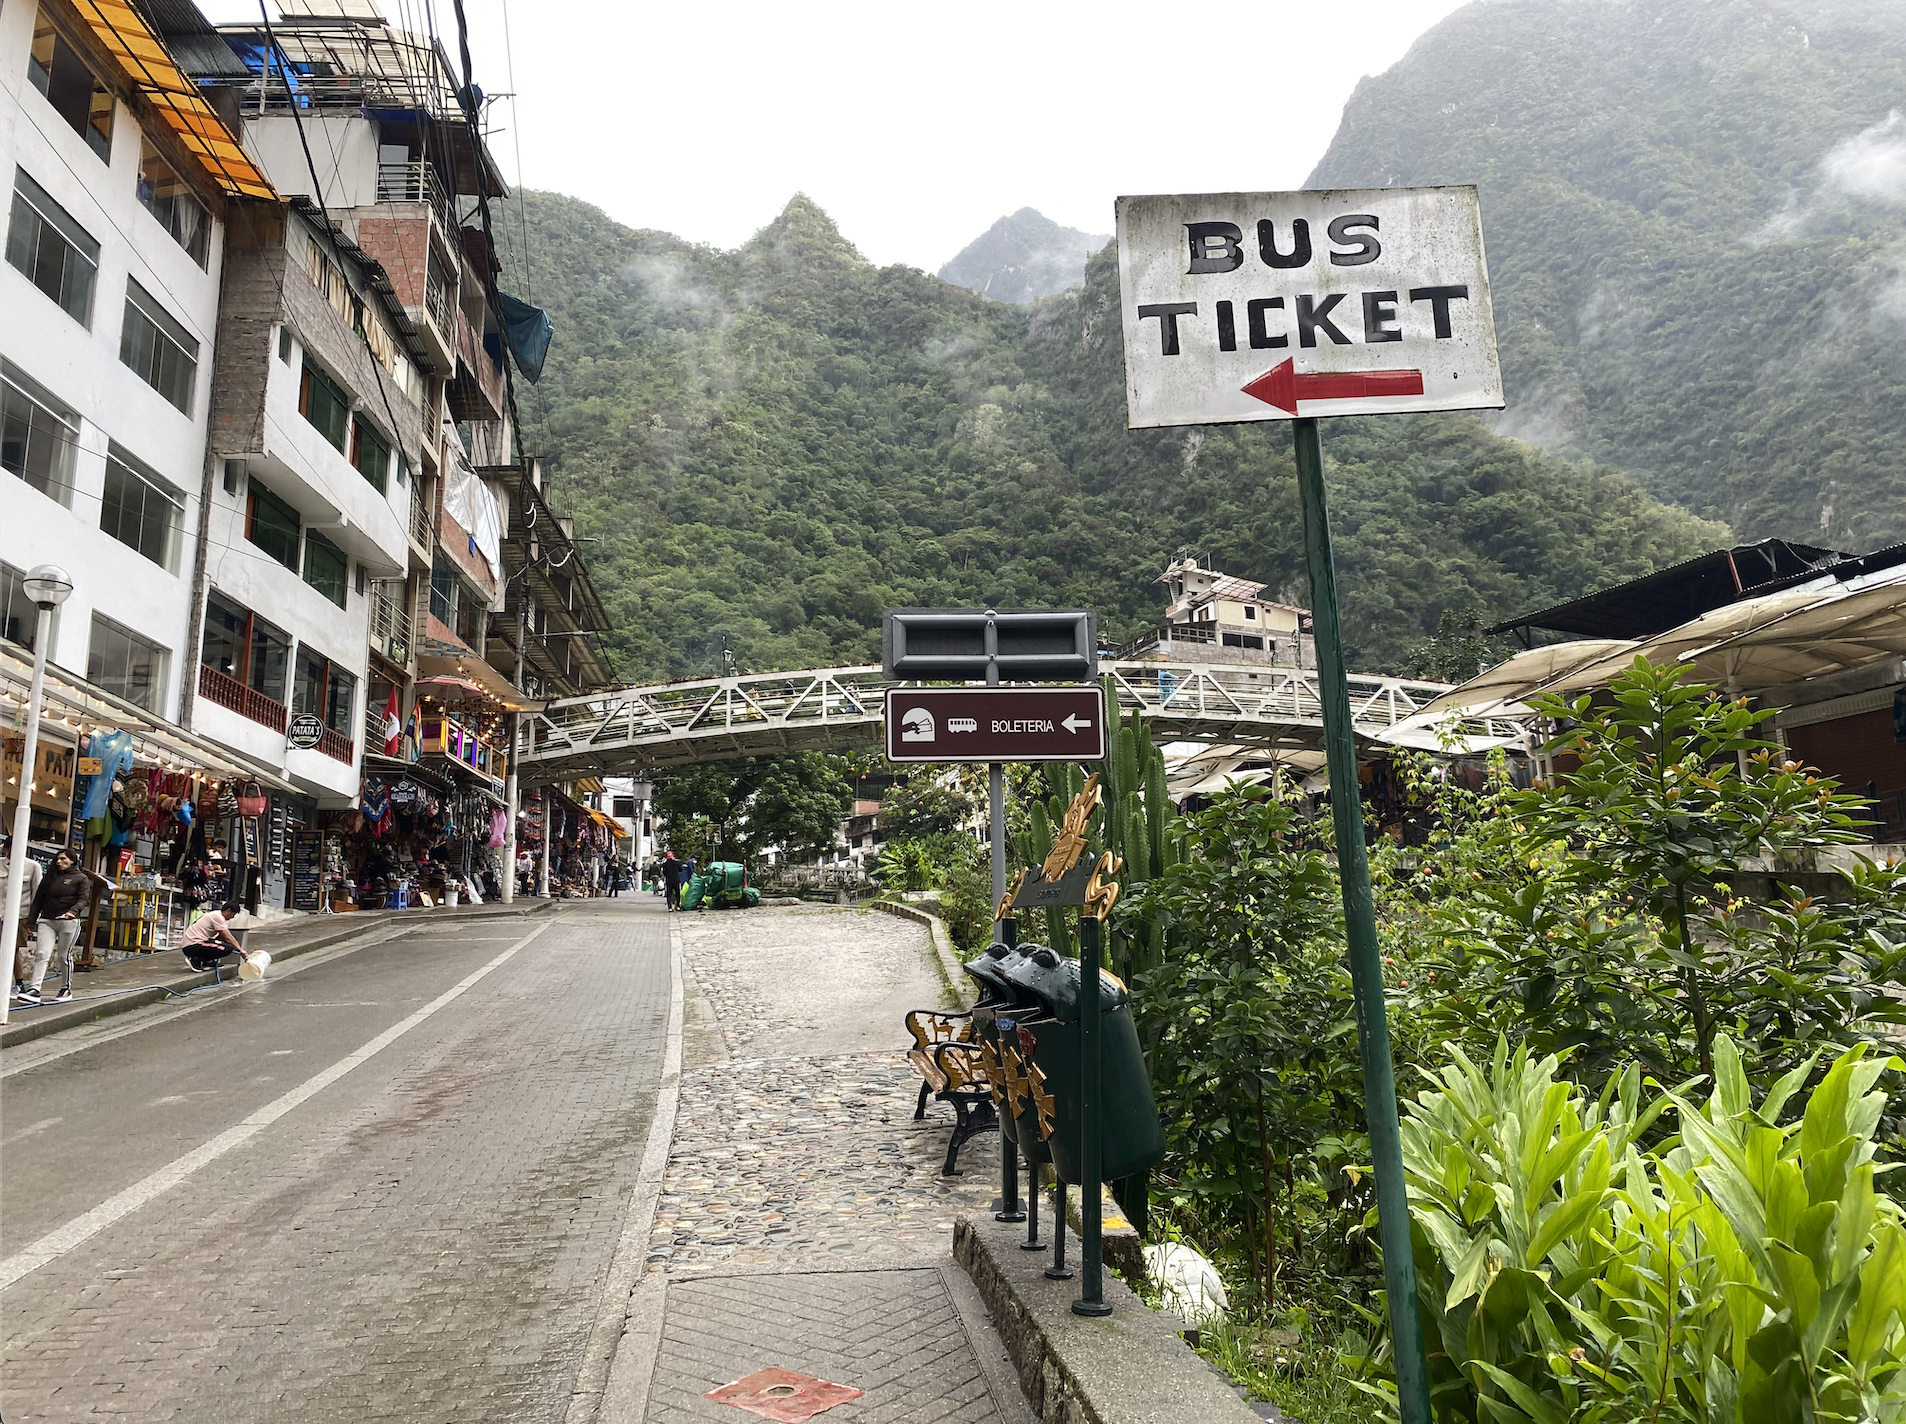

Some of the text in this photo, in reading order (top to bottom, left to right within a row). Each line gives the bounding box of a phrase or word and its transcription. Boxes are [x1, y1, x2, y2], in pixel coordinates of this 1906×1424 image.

[1183, 214, 1381, 274] BUS
[1138, 285, 1469, 356] TICKET
[292, 725, 320, 736] PATATA'S
[991, 719, 1055, 733] BOLETERIA
